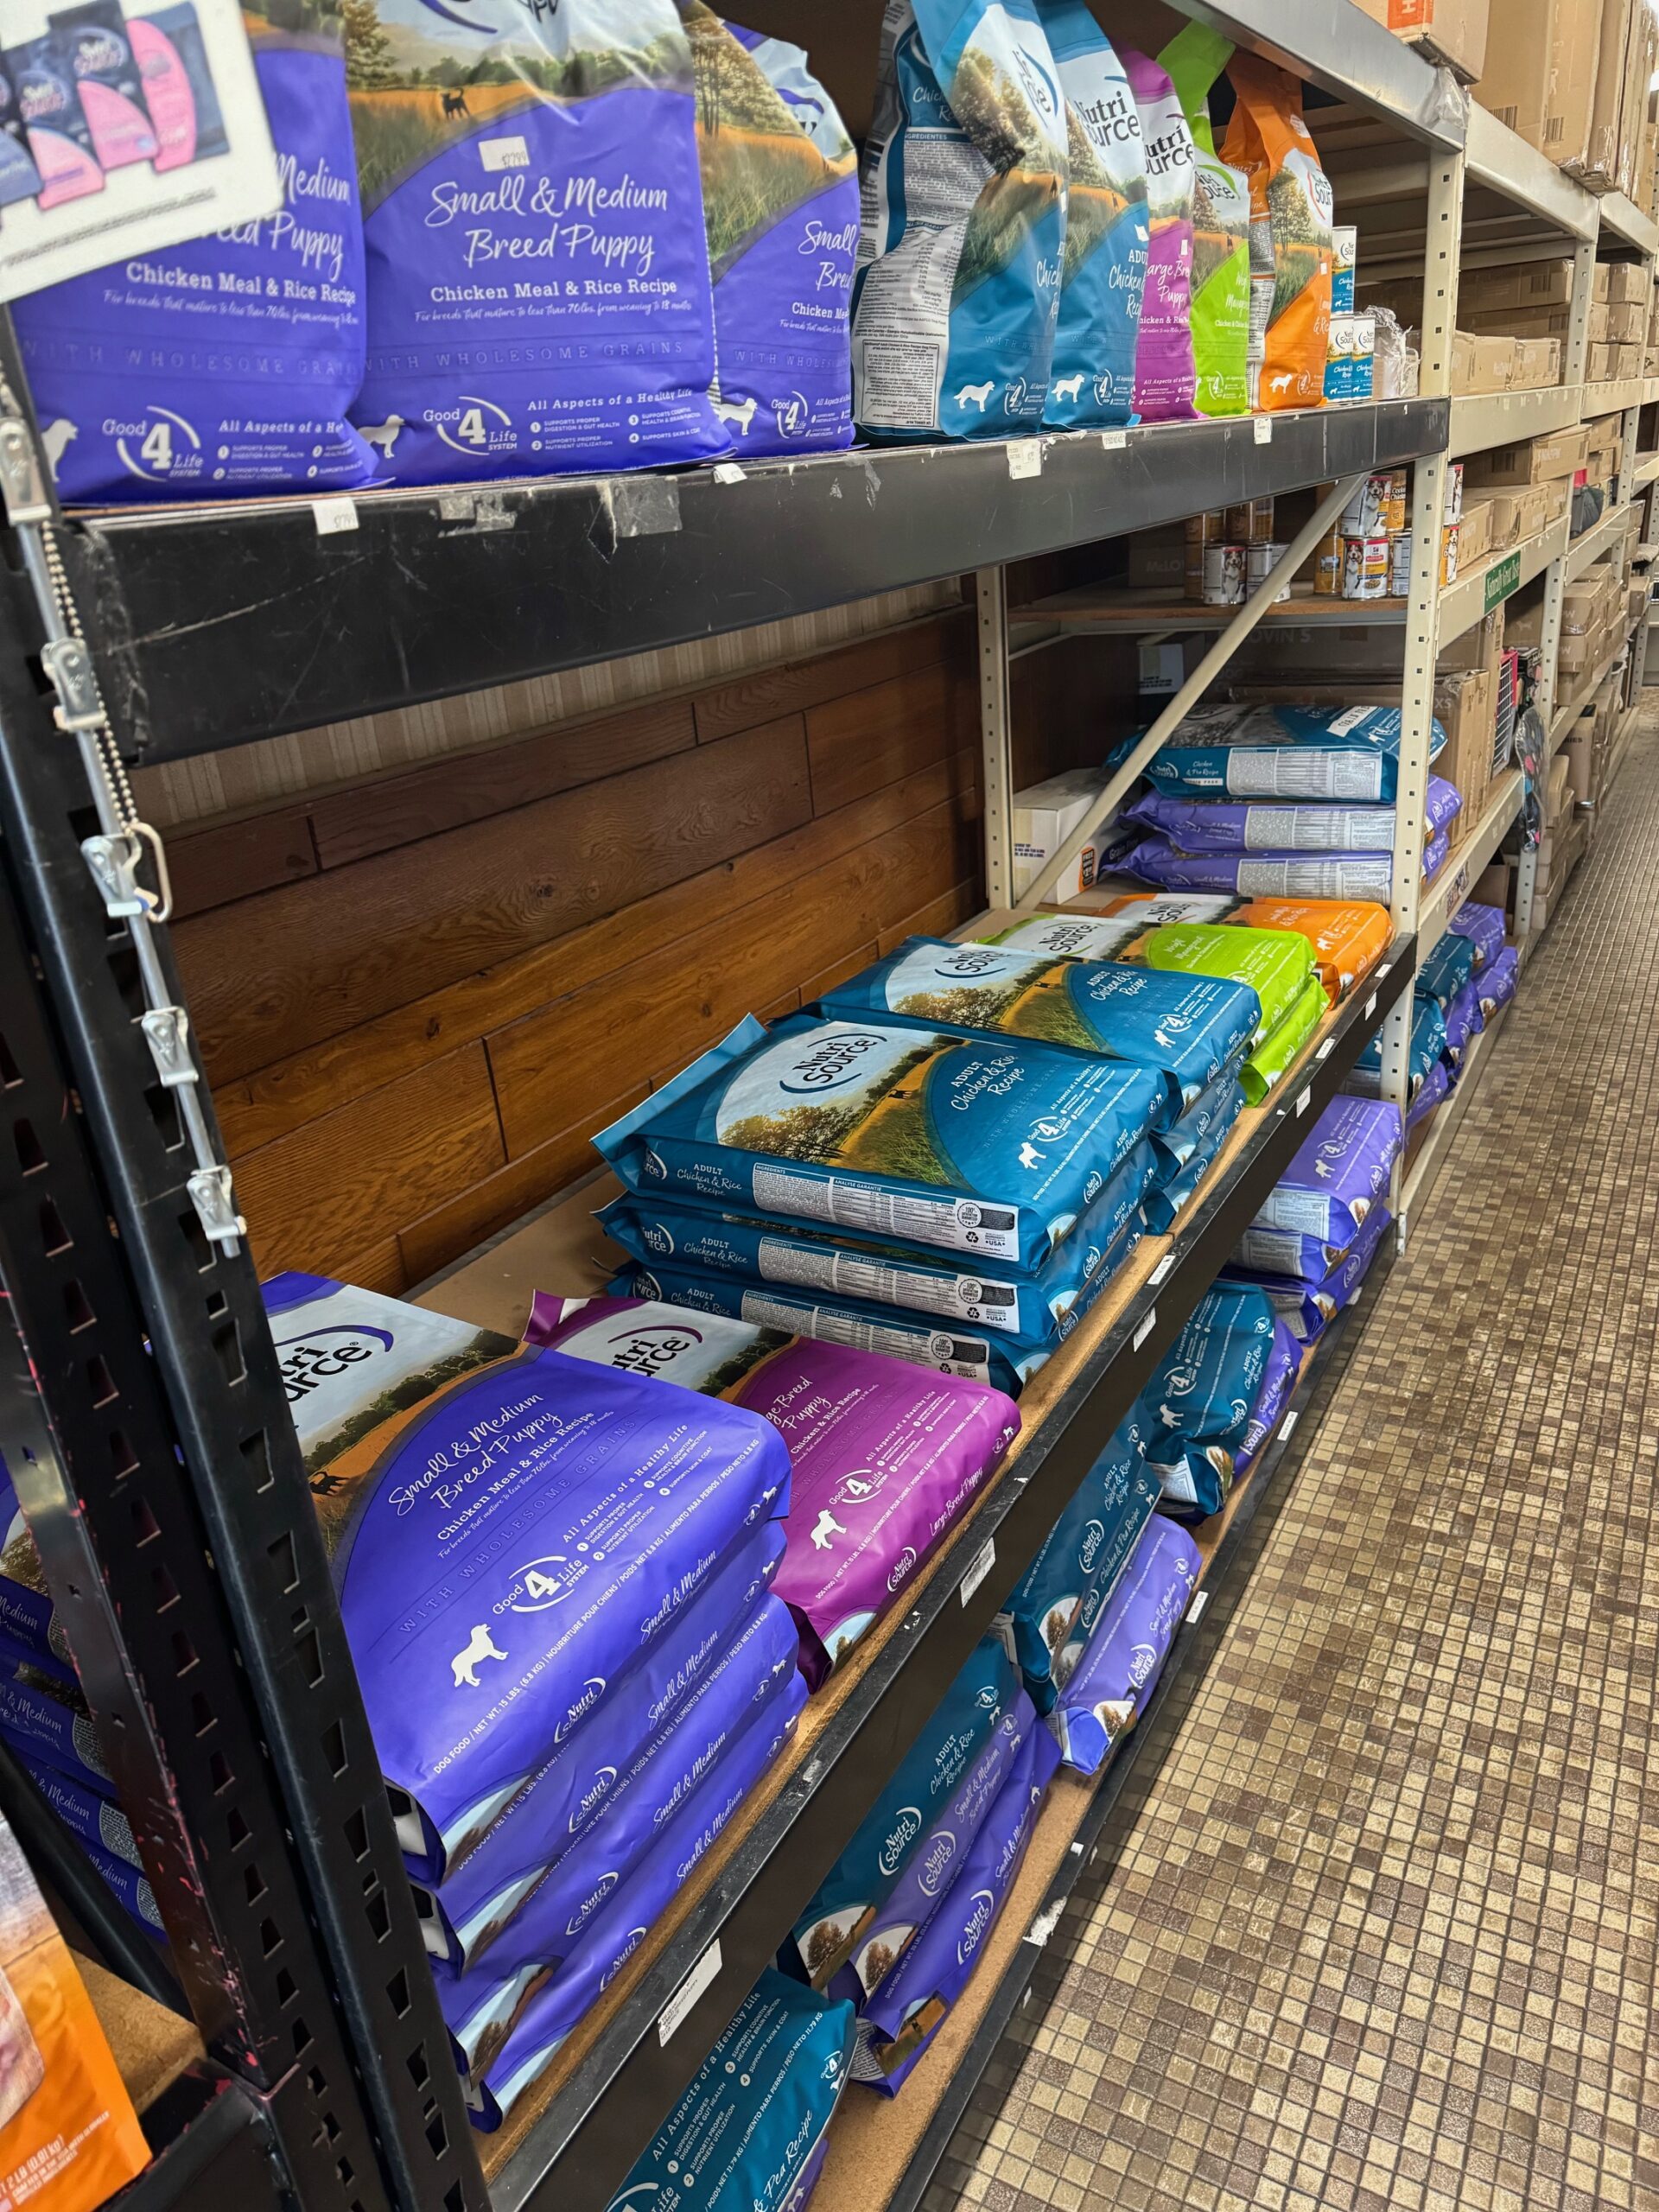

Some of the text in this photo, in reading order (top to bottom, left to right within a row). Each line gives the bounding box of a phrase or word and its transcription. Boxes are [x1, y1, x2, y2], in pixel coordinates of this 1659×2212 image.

[424, 174, 669, 227] Small & Medium
[268, 210, 343, 282] Puppy
[463, 223, 655, 276] Breed Puppy
[798, 221, 857, 257] Small
[125, 262, 213, 291] Chicken
[218, 272, 261, 296] Meal
[265, 278, 279, 297] &
[283, 280, 316, 301] Rice
[430, 278, 677, 302] Chicken Meal & Rice Recipe
[1147, 264, 1173, 286] arge
[791, 302, 832, 318] Chicken
[436, 340, 683, 367] WHOLESOME GRAINS
[423, 410, 460, 422] Good
[528, 399, 548, 411] All
[553, 397, 604, 410] Aspects
[637, 390, 675, 404] Healthy
[771, 398, 790, 410] Good
[102, 417, 148, 435] Good
[458, 408, 486, 445] 4
[489, 430, 517, 442] Life
[141, 423, 173, 470] 4
[488, 442, 518, 451] SYSTEM
[1039, 925, 1076, 945] Nutri
[1058, 923, 1099, 953] Source
[1088, 971, 1112, 987] ADULT
[792, 1040, 850, 1071] Nutri
[803, 1038, 878, 1084] Source
[950, 1061, 983, 1087] ADULT
[987, 1066, 1025, 1096] Recipe
[950, 1073, 994, 1111] Chicken
[1028, 1128, 1040, 1141] Good
[1037, 1122, 1059, 1138] 4
[677, 1168, 742, 1191] Chicken Rice
[694, 1162, 723, 1177] ADULT
[756, 1165, 786, 1175] INGREDIENTS
[834, 1178, 882, 1192] ANALYSE GARANTIE
[696, 1182, 726, 1198] Recipe
[683, 1242, 749, 1264] Chicken Rice
[700, 1236, 730, 1249] ADULT
[763, 1239, 793, 1249] INGREDIENTS
[703, 1256, 732, 1269] Recipe
[840, 1253, 887, 1268] ANALYSE GARANTIE
[687, 1288, 715, 1301] ADULT
[776, 1376, 813, 1412] Breed
[780, 1395, 831, 1431] Puppy
[791, 1387, 861, 1455] Chicken Rice Recipe
[388, 1394, 543, 1516] Small Medium
[429, 1412, 564, 1509] Breed Puppy
[437, 1412, 594, 1541] Chicken Meal & Rice Recipe
[563, 1425, 688, 1543] All Aspects Healthy Life
[845, 1477, 871, 1497] 4
[868, 1471, 883, 1487] Life
[1103, 1464, 1117, 1490] ADULT
[664, 1454, 746, 1536] ALIMENTO PARA PERROS PESO NETO
[829, 1486, 848, 1505] Good
[397, 1419, 636, 1634] WITH WHOLESOME GRAINS
[589, 1521, 615, 1544] DIGESTION
[930, 1502, 947, 1536] Large
[1082, 1528, 1096, 1551] Nutri
[1083, 1531, 1103, 1570] Source
[523, 1569, 562, 1601] 4
[557, 1559, 582, 1581] Life
[567, 1564, 589, 1587] SYSTEM
[891, 1558, 913, 1586] Source
[492, 1584, 524, 1616] Good
[546, 1619, 584, 1659] NOURRITURE
[581, 1605, 600, 1623] POUR
[597, 1585, 618, 1606] CHIENS
[620, 1564, 638, 1583] POIDS
[635, 1554, 647, 1566] NET
[1131, 1651, 1146, 1674] Nutri
[1134, 1656, 1156, 1687] Source
[16, 1698, 62, 1735] Medium
[434, 1757, 451, 1774] DOG
[449, 1737, 470, 1758] FOOD
[474, 1719, 488, 1735] NET
[486, 1706, 502, 1721] WT.
[505, 1687, 521, 1701] LBS.
[531, 1661, 546, 1675] KG)
[567, 1686, 596, 1719] Nutri
[930, 1728, 976, 1796] Chicken Rice
[934, 1734, 957, 1767] ADULT
[48, 1783, 89, 1821] Medium
[884, 1817, 910, 1851] Nutri
[885, 1821, 918, 1869] Source
[89, 1854, 127, 1891] Medium
[924, 1840, 944, 1875] Nutri
[925, 1844, 953, 1893] Source
[963, 1903, 984, 1937] Nutri
[964, 1907, 990, 1959] Source
[652, 1992, 761, 2160] All Aspects Healthy Life
[744, 2032, 806, 2148] ALIMENTO PARA PERROS PESO NETO
[674, 2097, 709, 2156] SUPPORTS PROPER
[695, 2103, 735, 2175] NUTRIENT UTILIZATION
[764, 2109, 813, 2197] Pea Recipe
